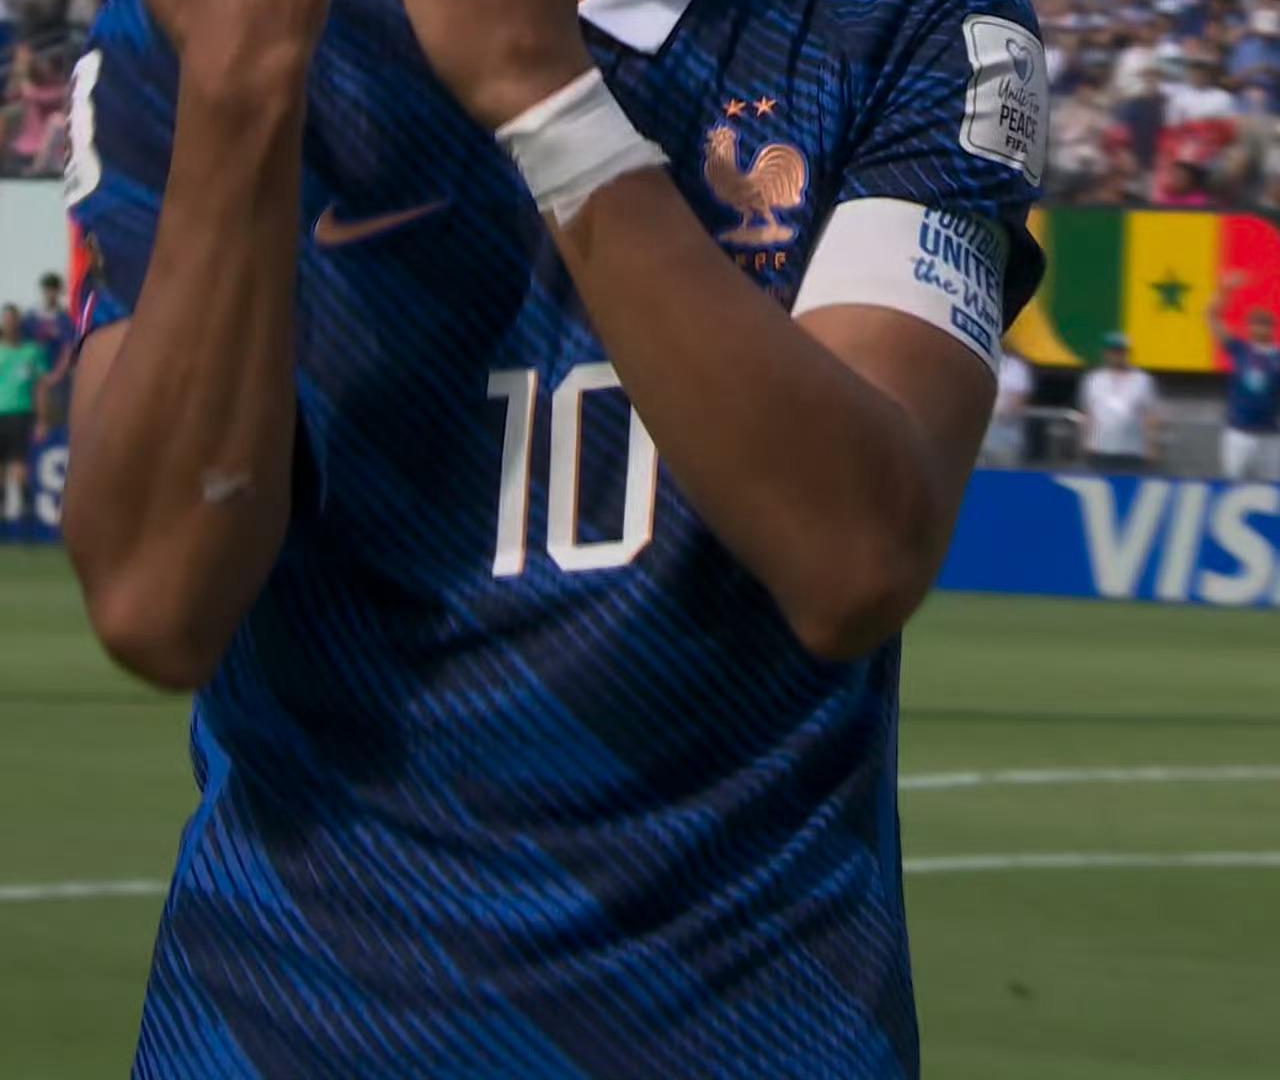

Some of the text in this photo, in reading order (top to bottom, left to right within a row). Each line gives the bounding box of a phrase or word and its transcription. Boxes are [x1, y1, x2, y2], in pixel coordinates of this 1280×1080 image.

[998, 104, 1039, 143] PEACE
[919, 221, 1002, 302] UNITE
[487, 361, 659, 579] 10
